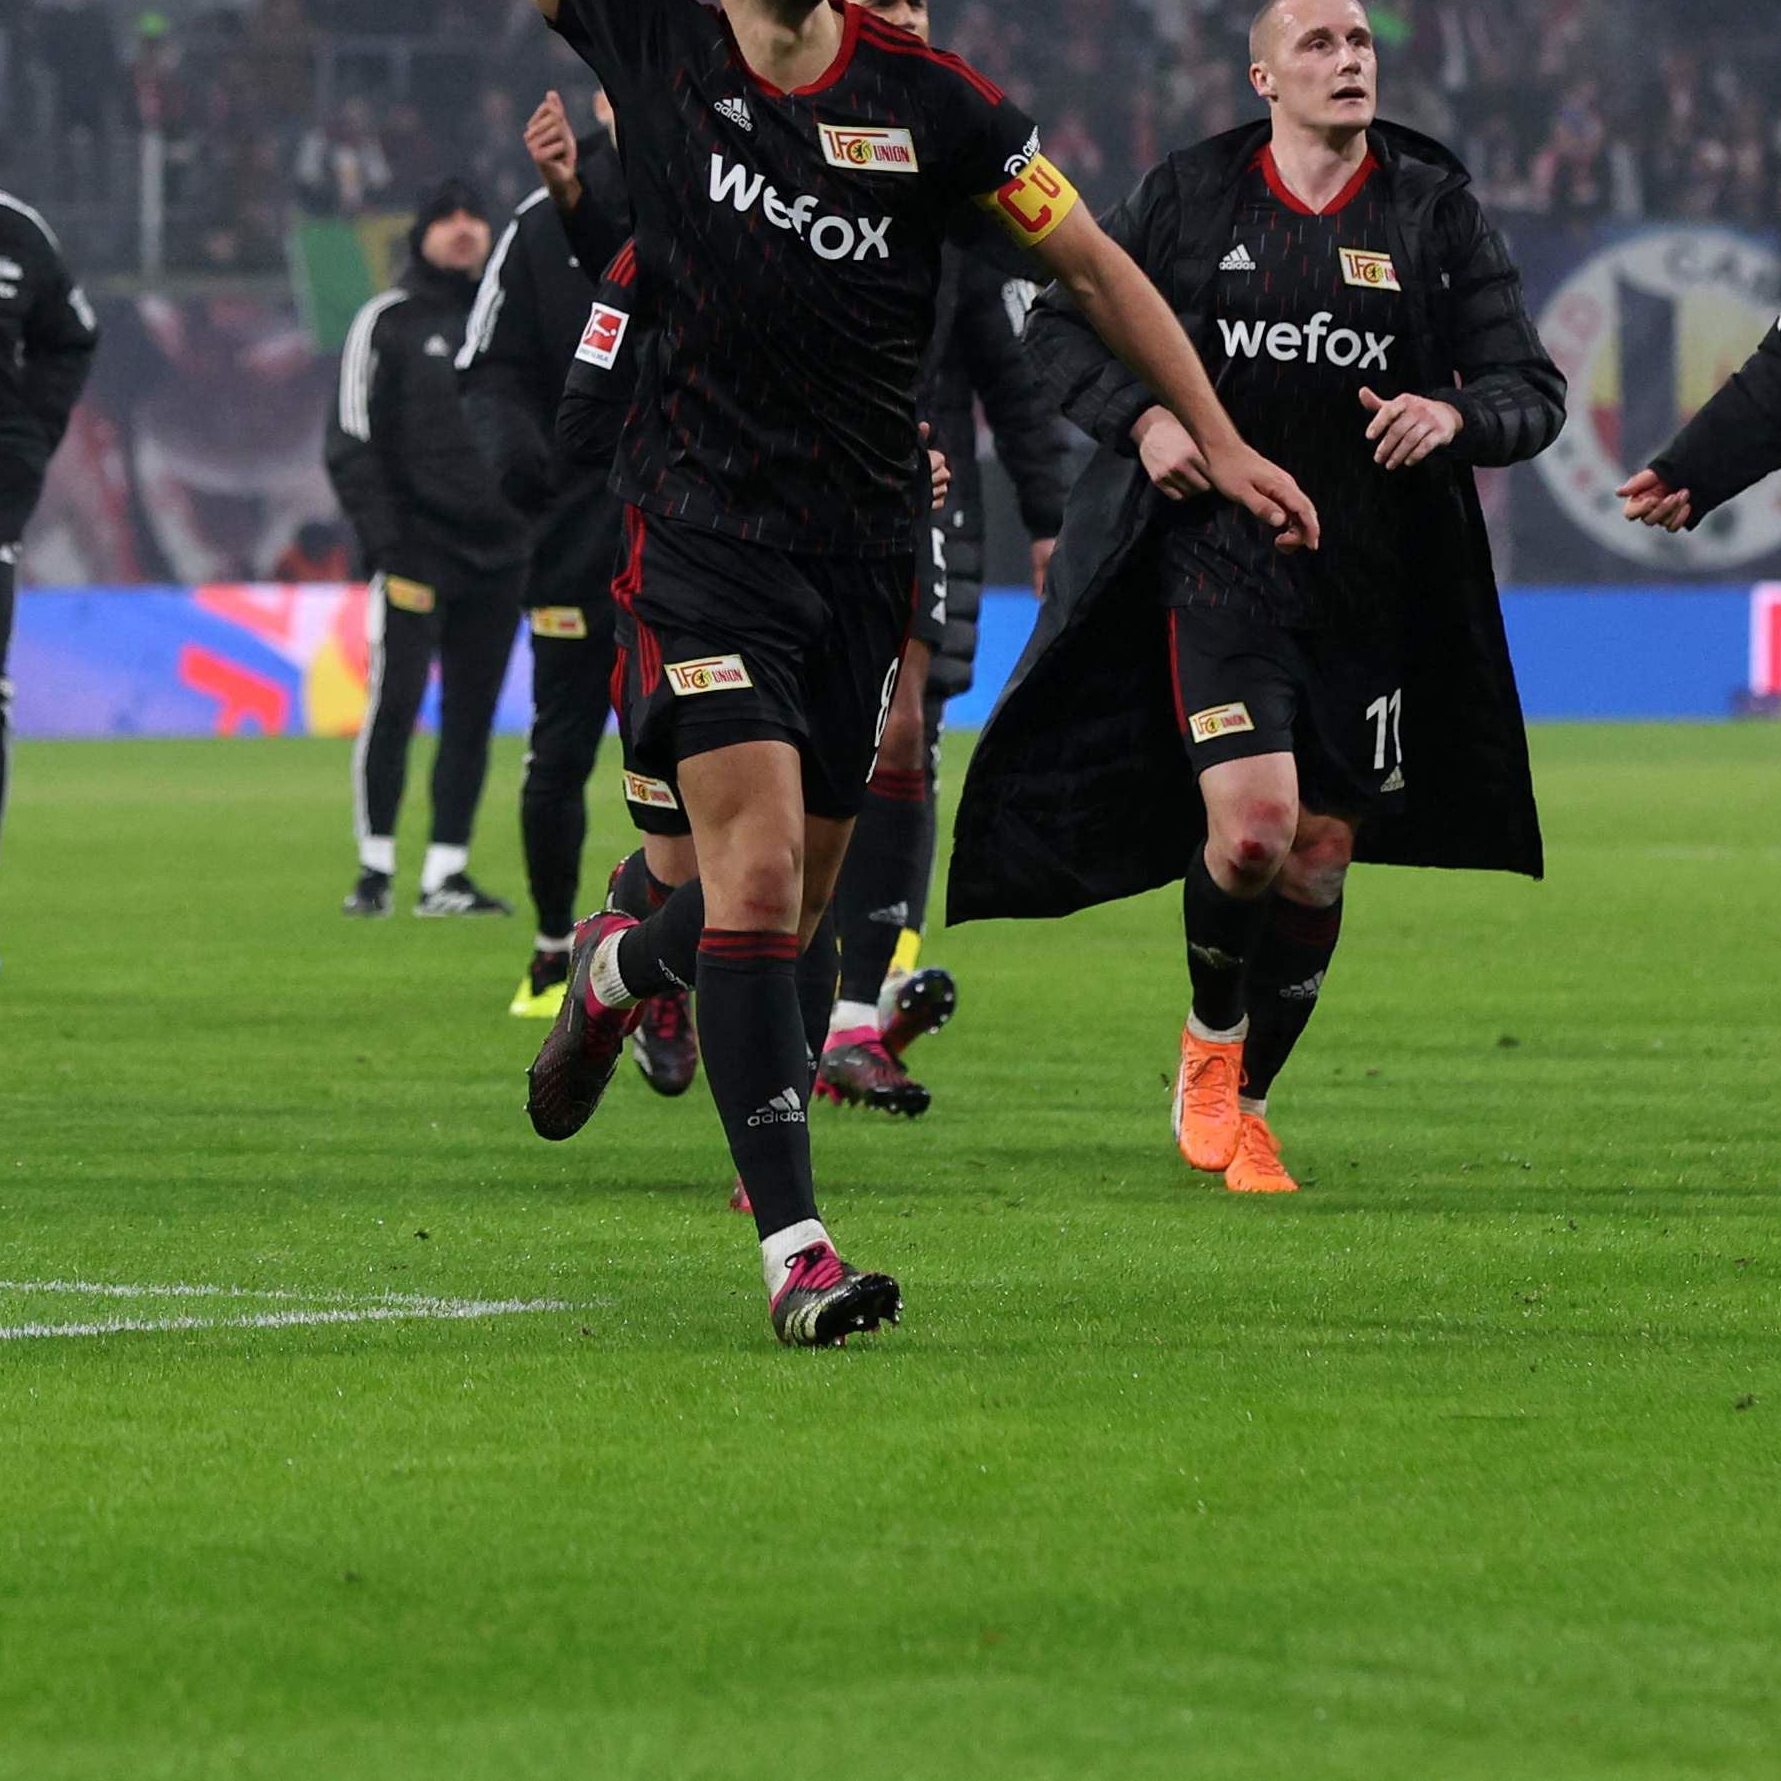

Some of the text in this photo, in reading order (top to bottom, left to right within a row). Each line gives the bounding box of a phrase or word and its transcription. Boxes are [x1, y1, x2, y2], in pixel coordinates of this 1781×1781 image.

[714, 101, 754, 132] adidas
[874, 144, 910, 164] UNION
[709, 153, 892, 261] wefox
[1219, 259, 1256, 271] adidas
[1217, 311, 1396, 371] wefox
[713, 667, 743, 684] UNION
[1366, 688, 1403, 770] 11
[747, 1108, 806, 1127] adidas
